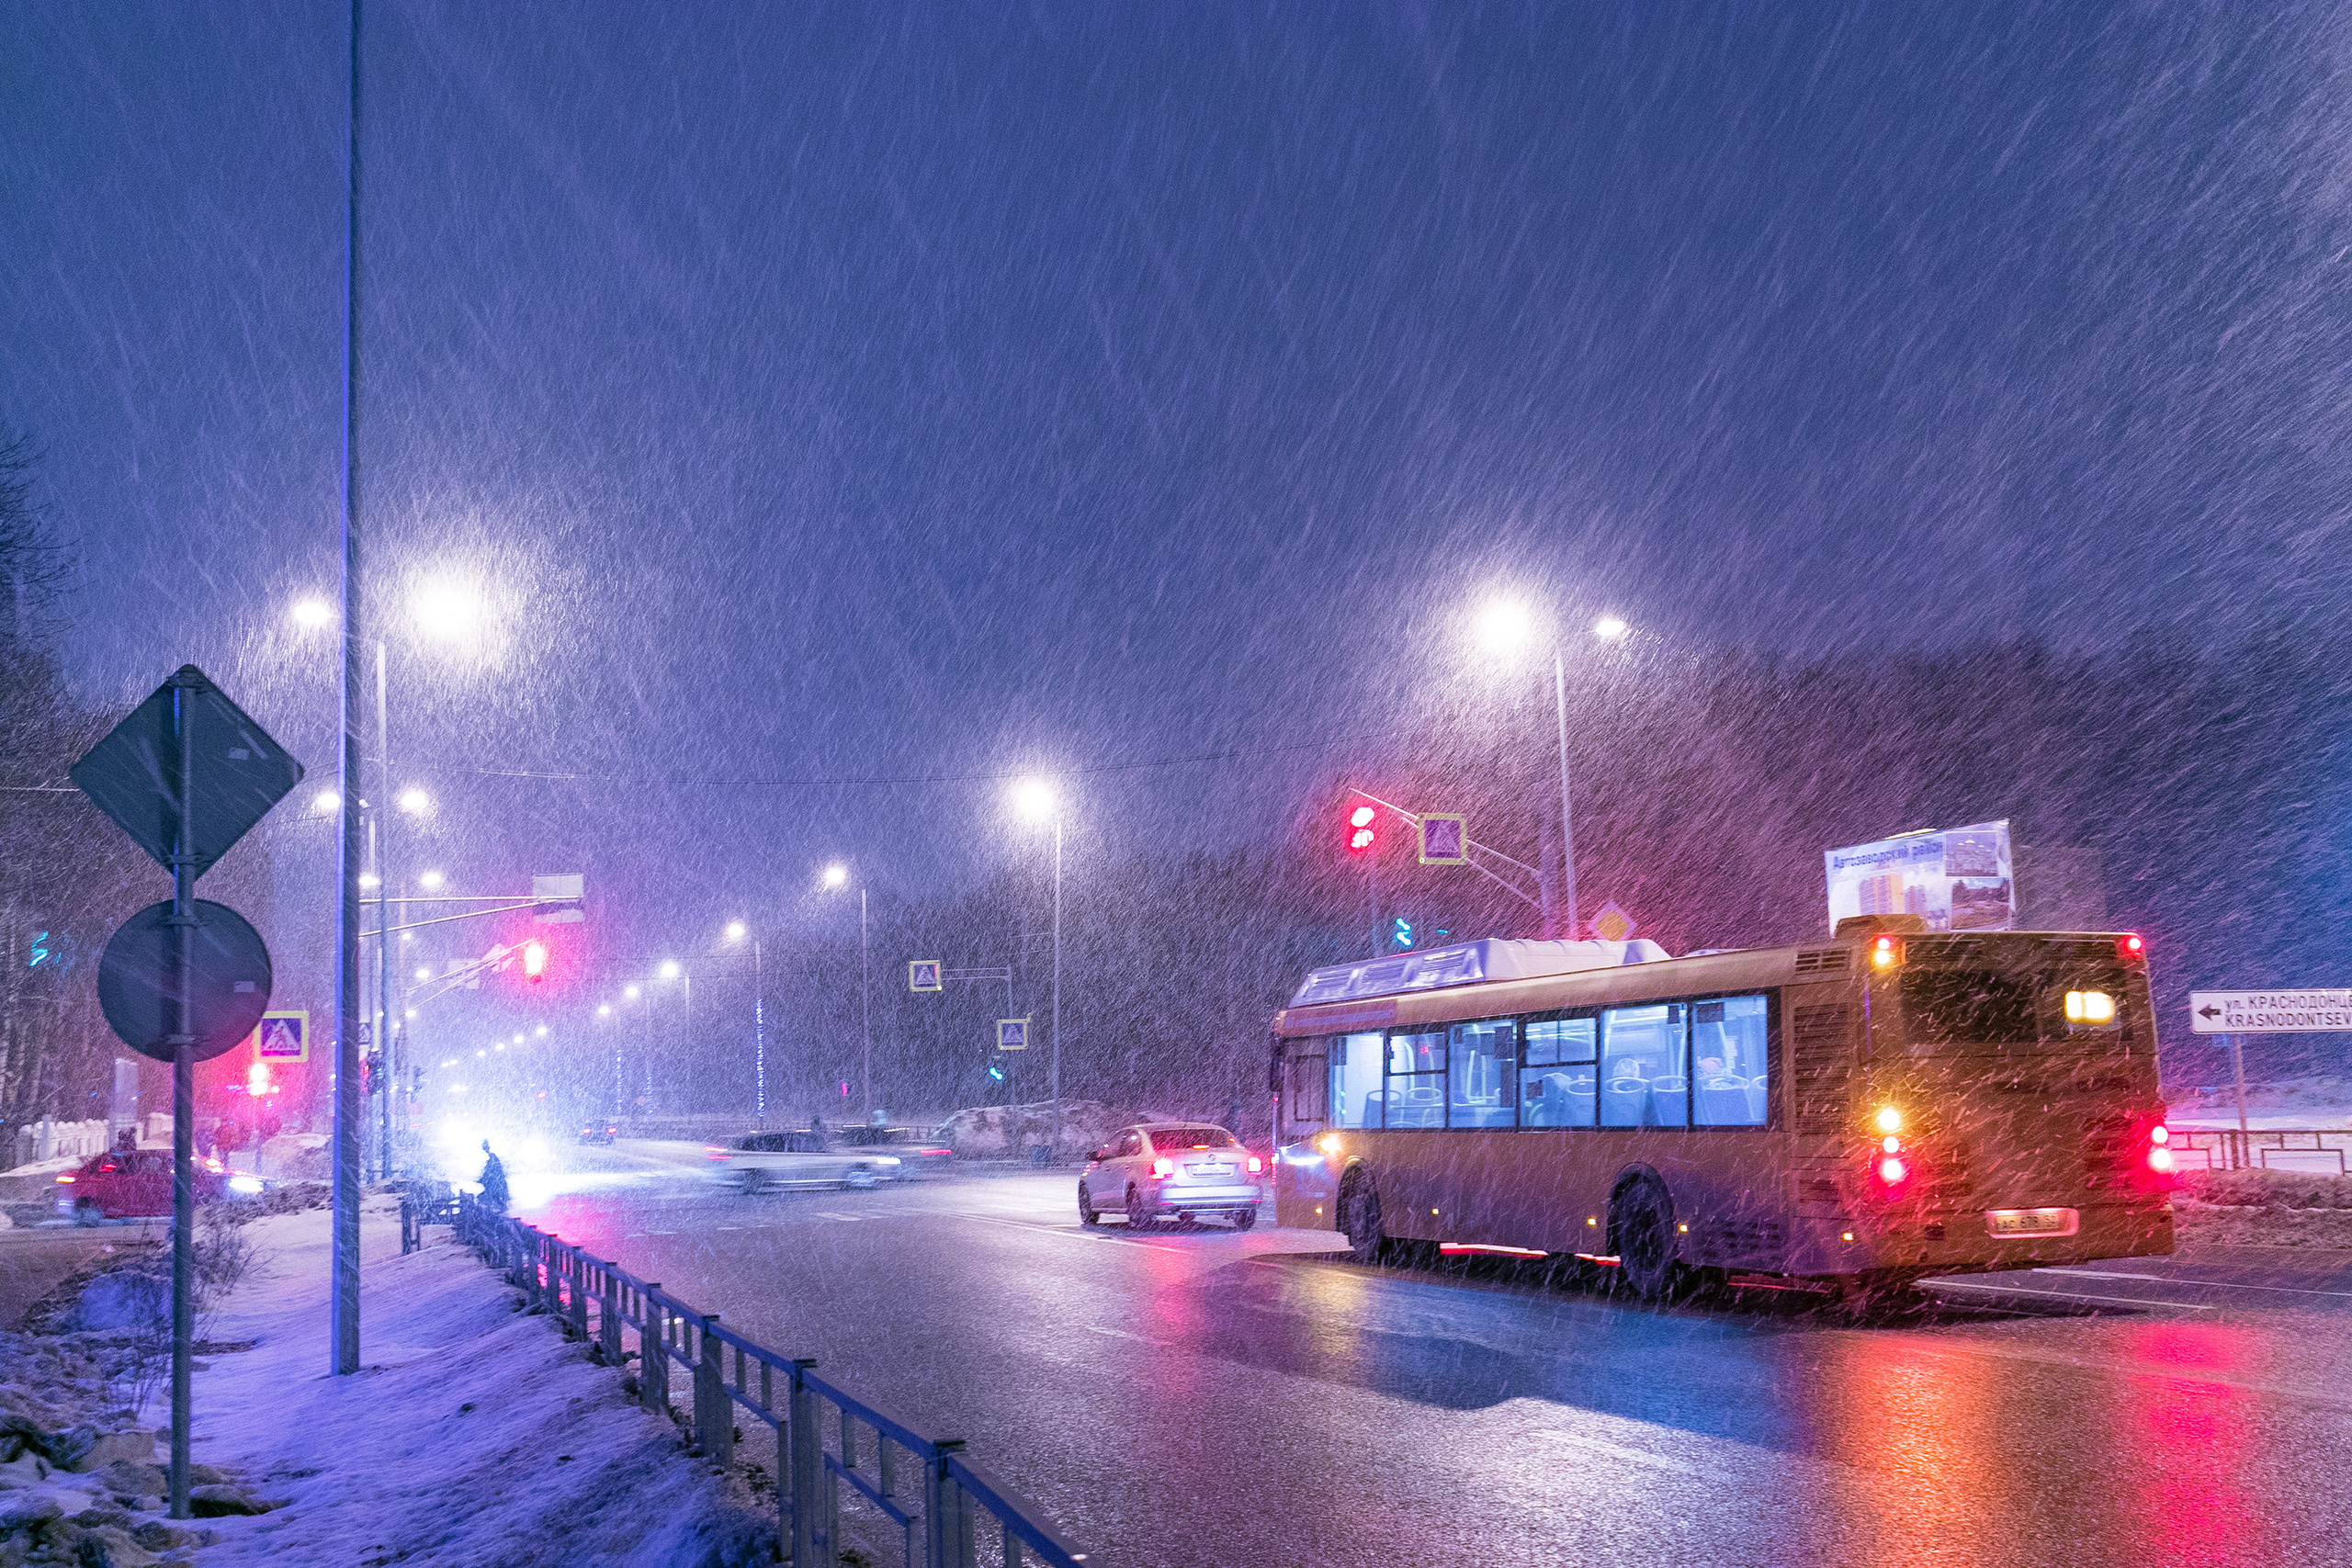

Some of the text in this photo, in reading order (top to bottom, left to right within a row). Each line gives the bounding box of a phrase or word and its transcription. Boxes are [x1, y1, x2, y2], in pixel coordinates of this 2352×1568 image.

[1833, 845, 1908, 869] Автозаводский
[2224, 999, 2245, 1013] ул.
[2224, 1011, 2352, 1027] KRASNODONTSEV
